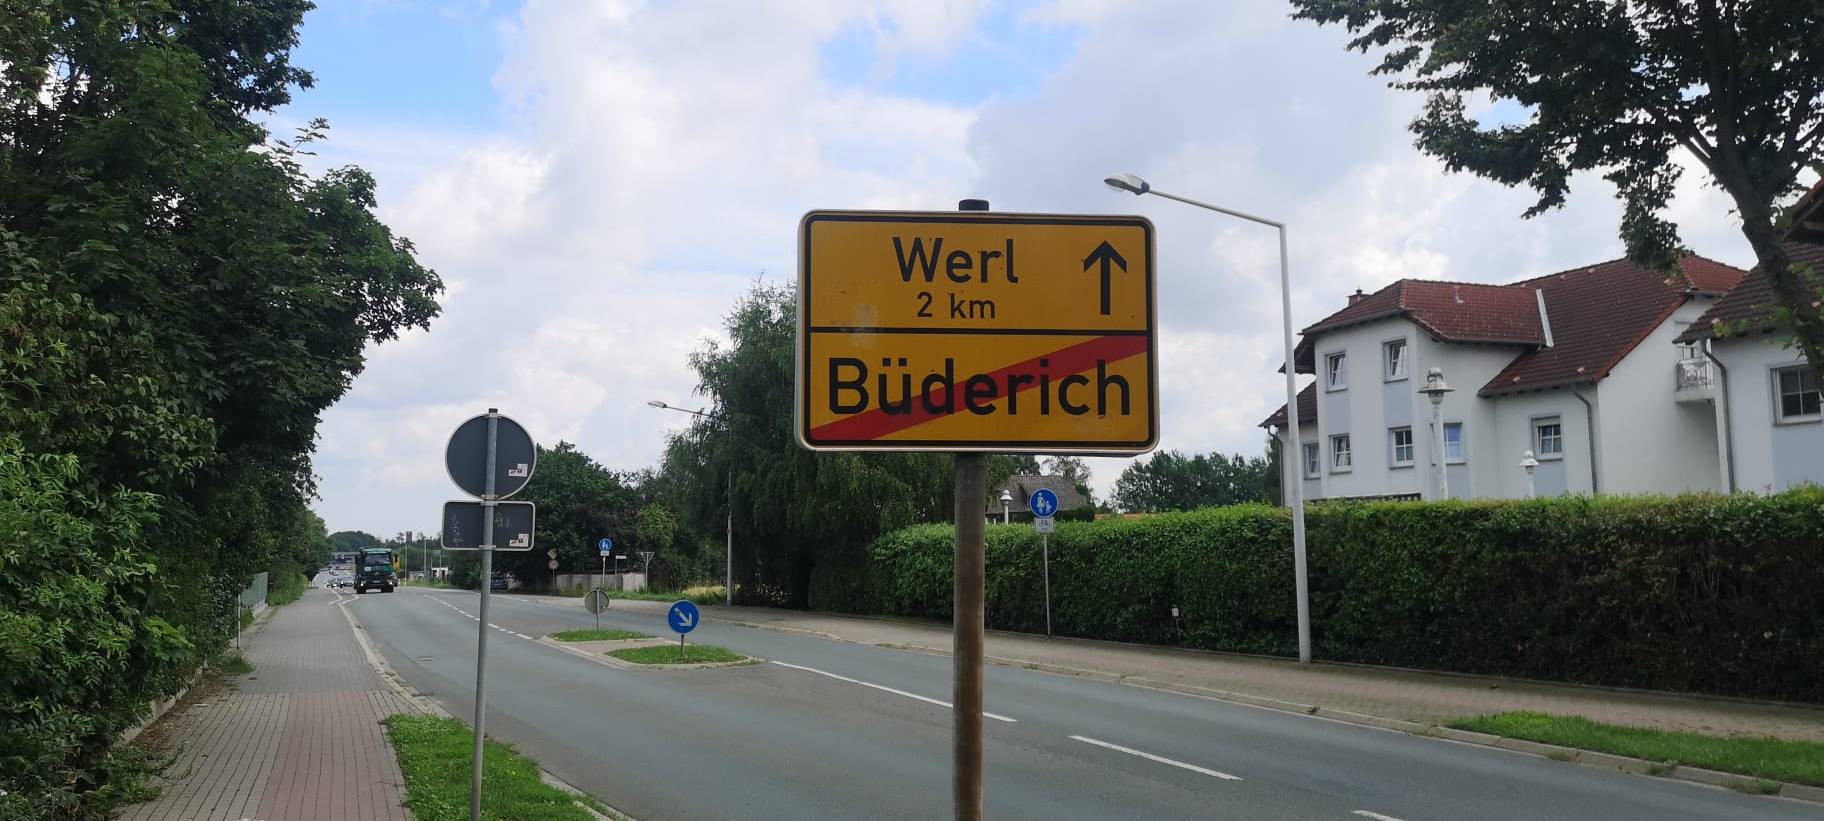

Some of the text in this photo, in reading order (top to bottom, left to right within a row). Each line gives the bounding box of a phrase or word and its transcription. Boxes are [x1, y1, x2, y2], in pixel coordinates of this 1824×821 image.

[892, 236, 1019, 284] Werl
[916, 291, 996, 319] 2 km
[828, 357, 1131, 417] Büderich
